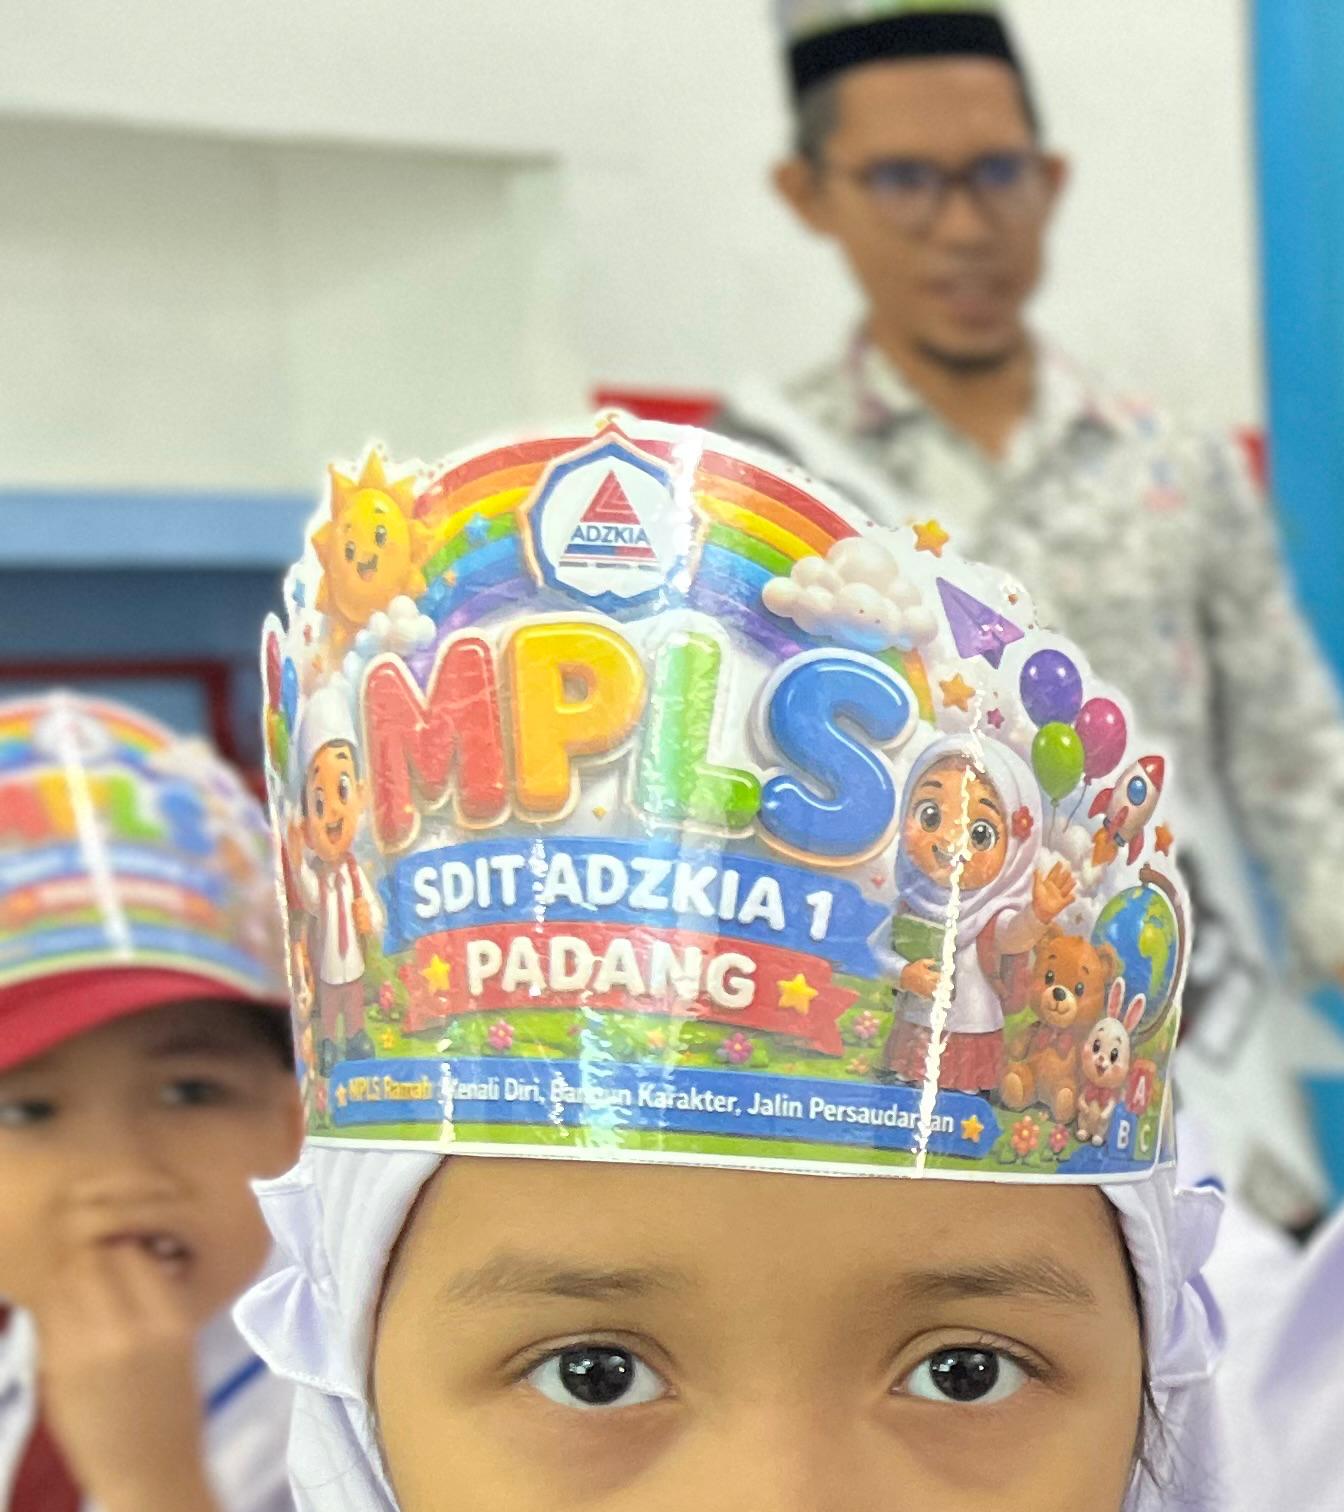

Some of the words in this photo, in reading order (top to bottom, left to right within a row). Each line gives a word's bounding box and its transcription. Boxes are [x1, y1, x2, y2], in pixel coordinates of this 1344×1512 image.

[570, 524, 651, 546] ADZKIA
[364, 621, 912, 856] MPLS
[412, 853, 526, 920] SDIT
[544, 852, 787, 931] ADZKIA
[805, 890, 834, 942] 1
[466, 936, 757, 1010] PADANG
[637, 1083, 742, 1117] Karakter,
[748, 1092, 803, 1119] Jalin
[809, 1097, 955, 1133] Persaudaran
